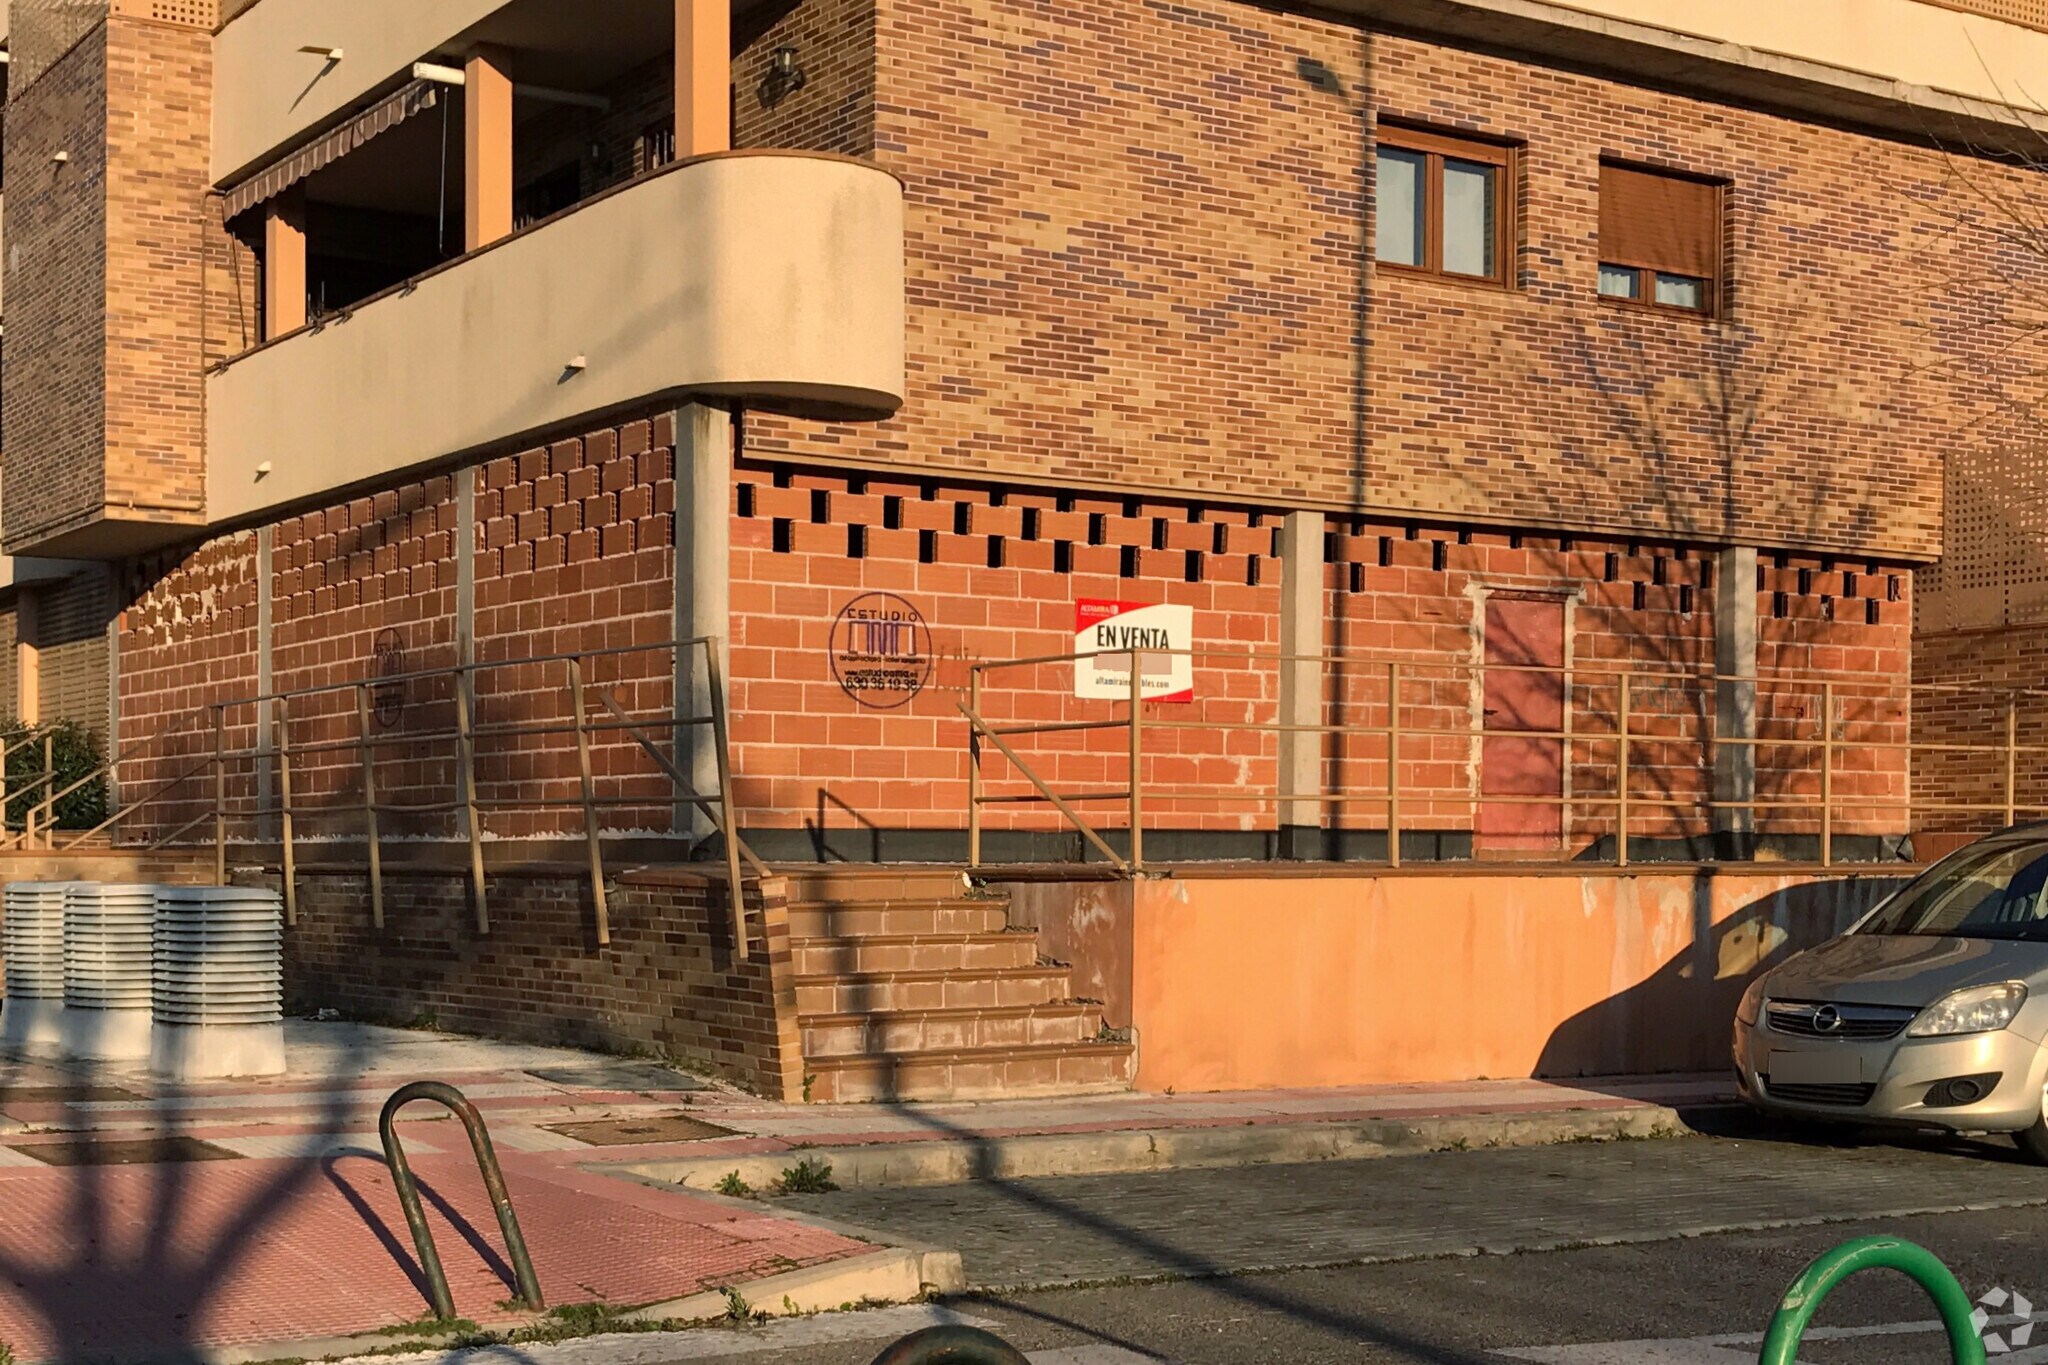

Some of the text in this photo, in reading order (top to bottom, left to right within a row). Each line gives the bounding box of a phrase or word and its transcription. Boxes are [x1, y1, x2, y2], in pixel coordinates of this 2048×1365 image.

[847, 609, 918, 622] ESTUDIO
[1097, 625, 1169, 649] EN VENTA
[870, 677, 885, 690] 36
